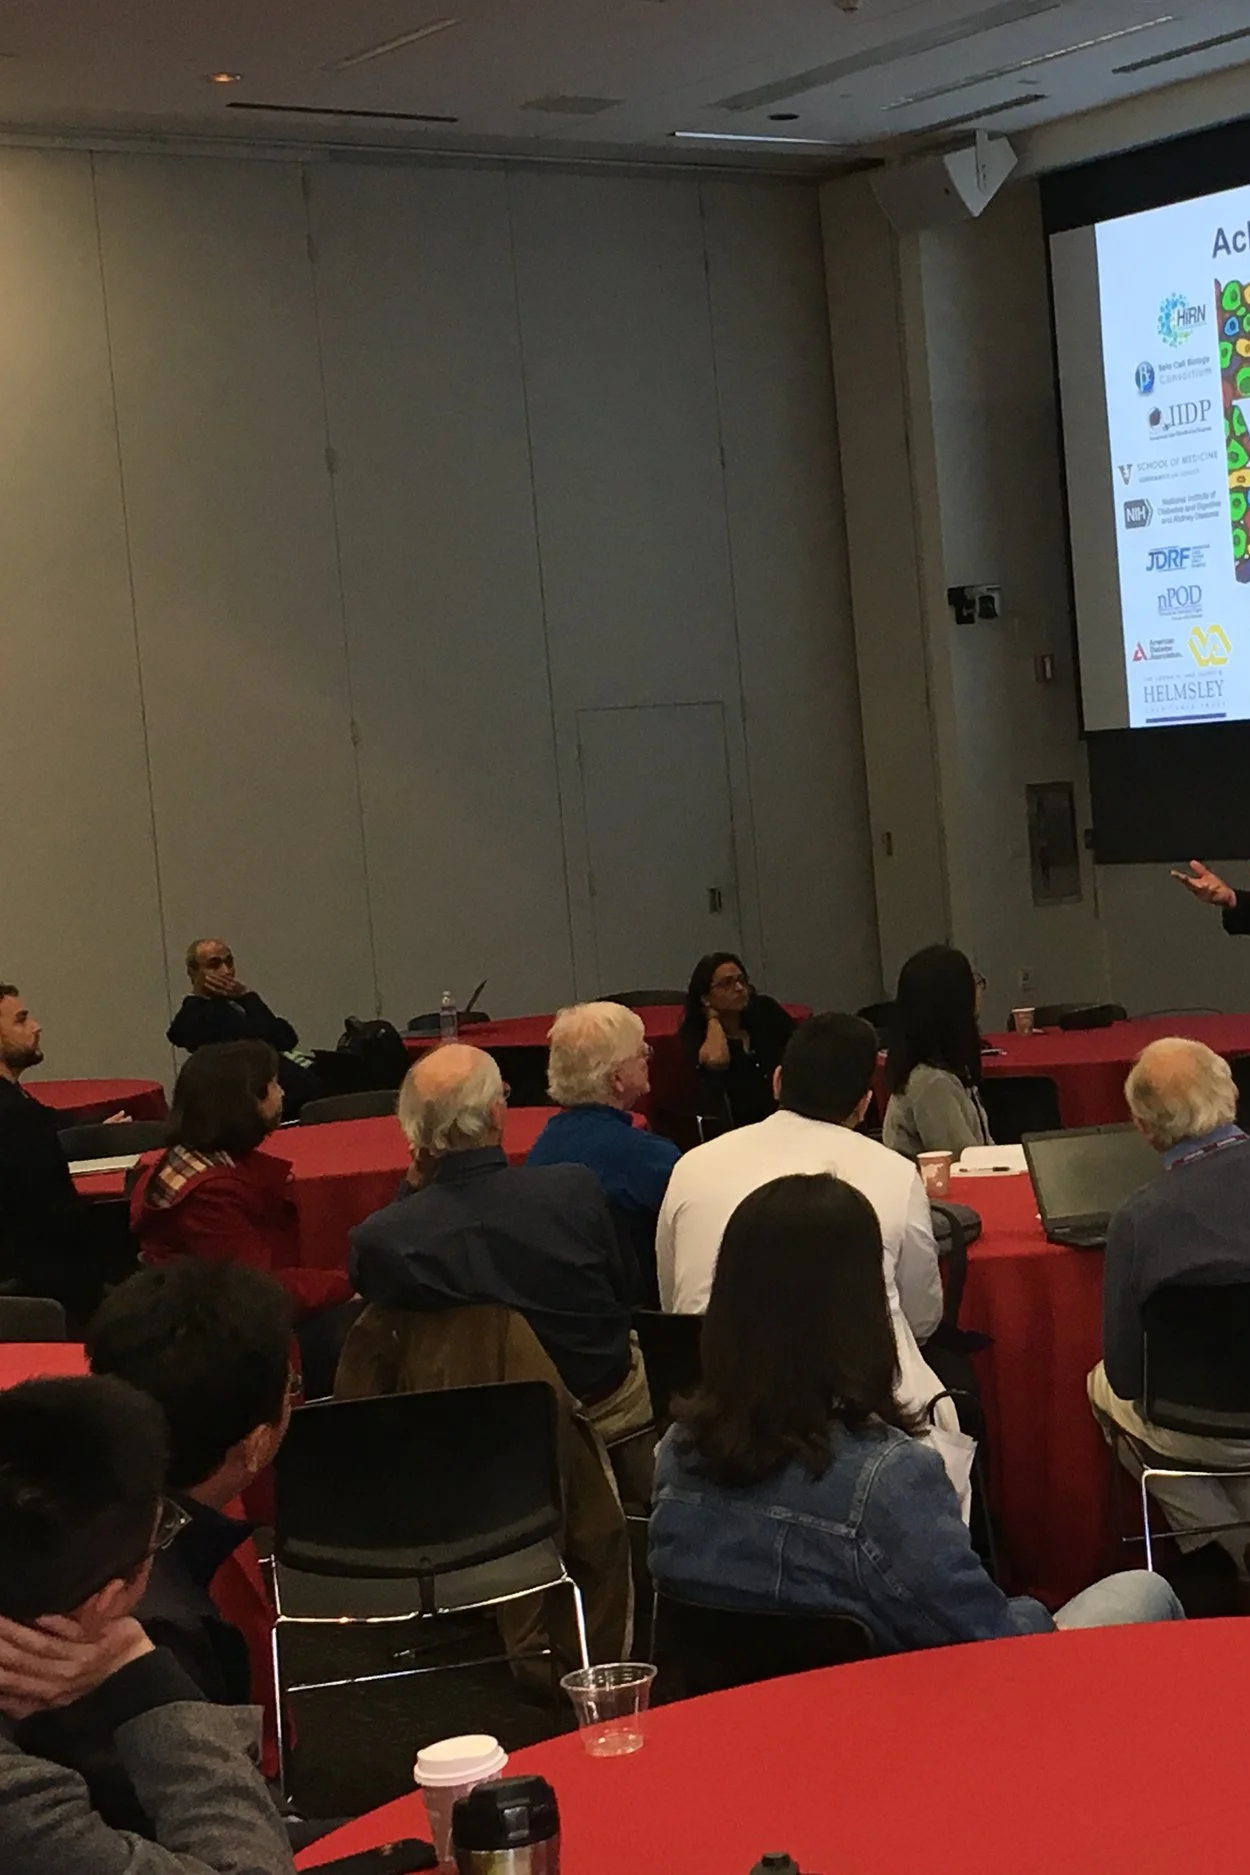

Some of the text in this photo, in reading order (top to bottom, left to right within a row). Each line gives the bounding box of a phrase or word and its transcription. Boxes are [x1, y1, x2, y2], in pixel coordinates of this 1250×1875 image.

[1177, 304, 1206, 327] HiRN
[1126, 505, 1146, 522] NIH
[1146, 547, 1191, 571] JDRF
[1158, 584, 1202, 608] nPOD
[1144, 679, 1224, 703] HELMSLEY
